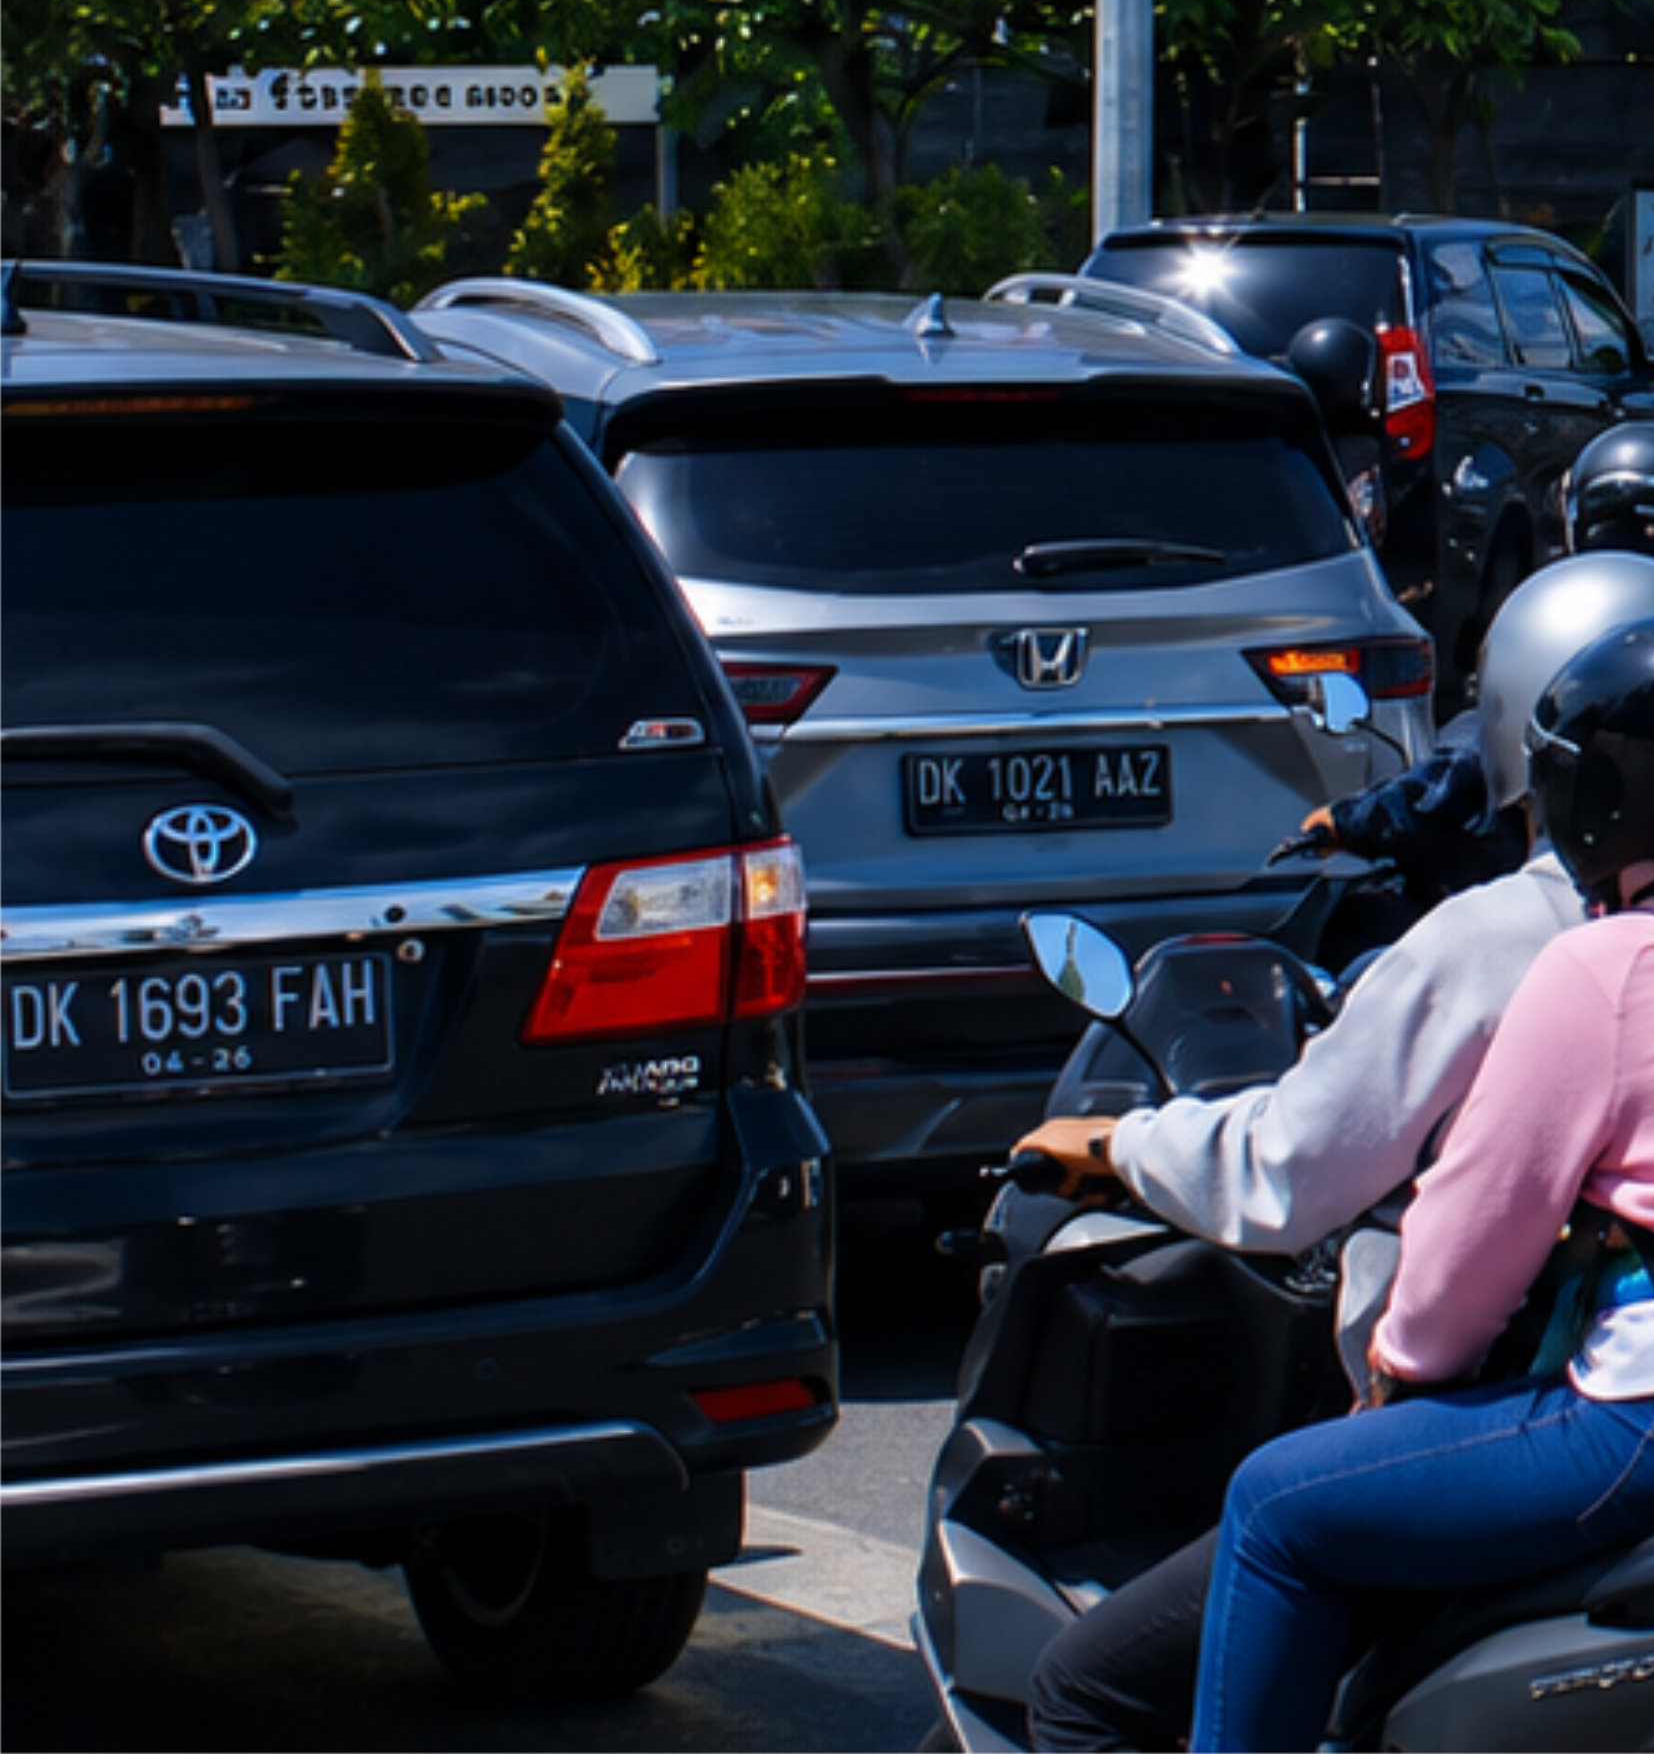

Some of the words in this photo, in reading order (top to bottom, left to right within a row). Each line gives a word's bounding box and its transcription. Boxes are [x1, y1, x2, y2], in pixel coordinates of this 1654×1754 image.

[918, 758, 967, 805] DK
[987, 754, 1073, 802] 1021
[1094, 749, 1161, 798] AAZ
[10, 980, 81, 1051] DK
[109, 970, 248, 1044] 1693
[271, 958, 376, 1033] FAH
